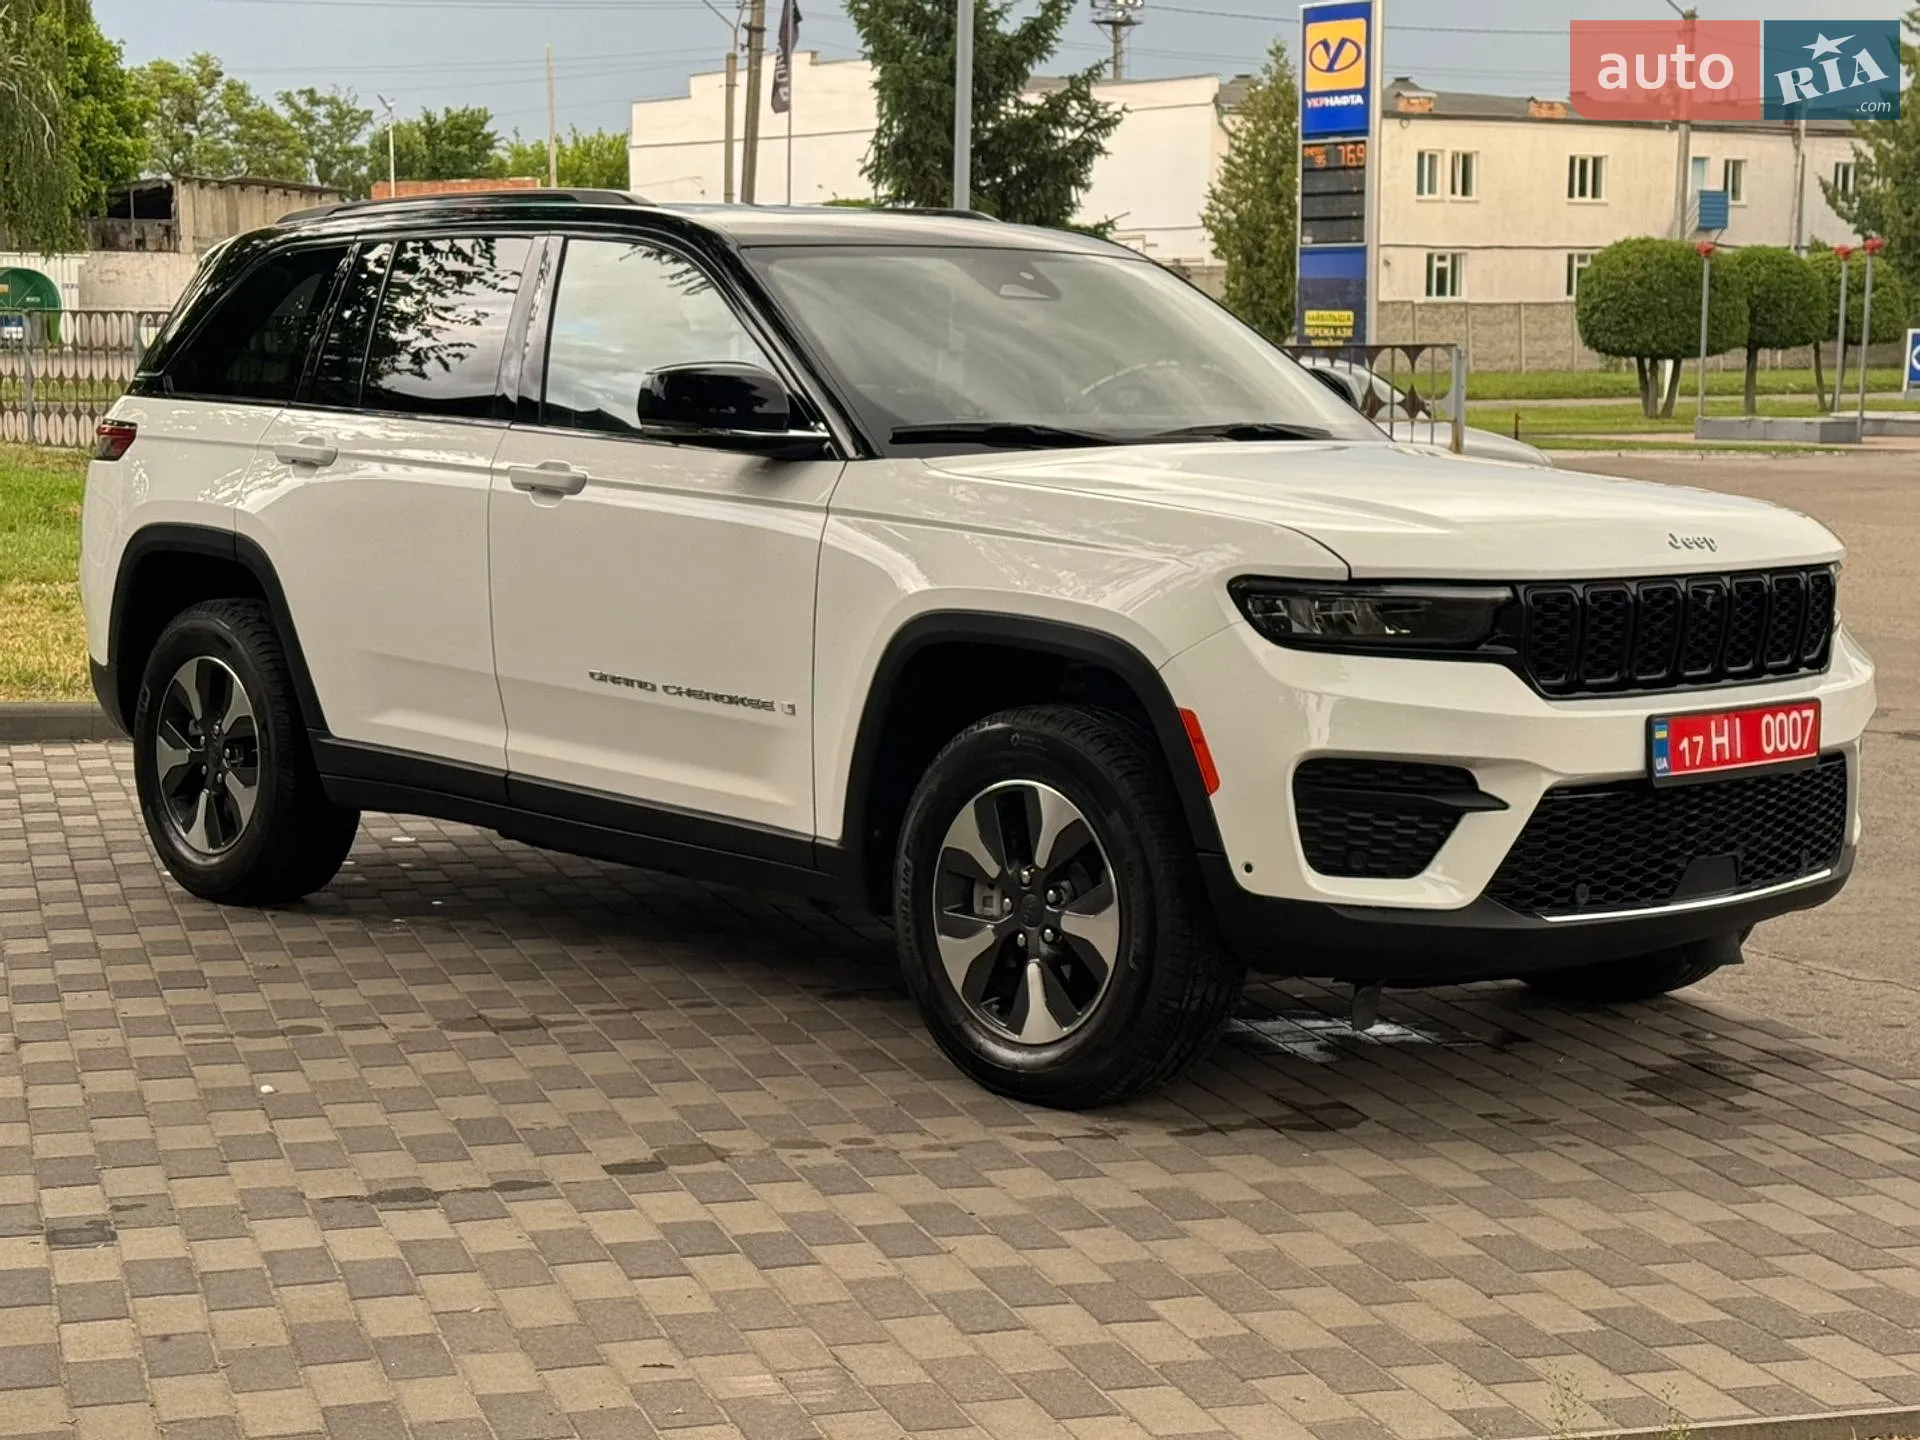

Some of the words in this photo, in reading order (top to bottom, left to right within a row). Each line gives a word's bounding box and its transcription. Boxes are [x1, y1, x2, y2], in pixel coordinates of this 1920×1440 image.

[1305, 94, 1364, 109] УКРНАФТА
[1668, 532, 1717, 552] Jeep
[588, 669, 657, 692] GRAND
[662, 684, 776, 712] CHEROKEE
[1679, 735, 1704, 767] 17
[1761, 709, 1815, 754] 0007
[1655, 757, 1669, 770] UA
